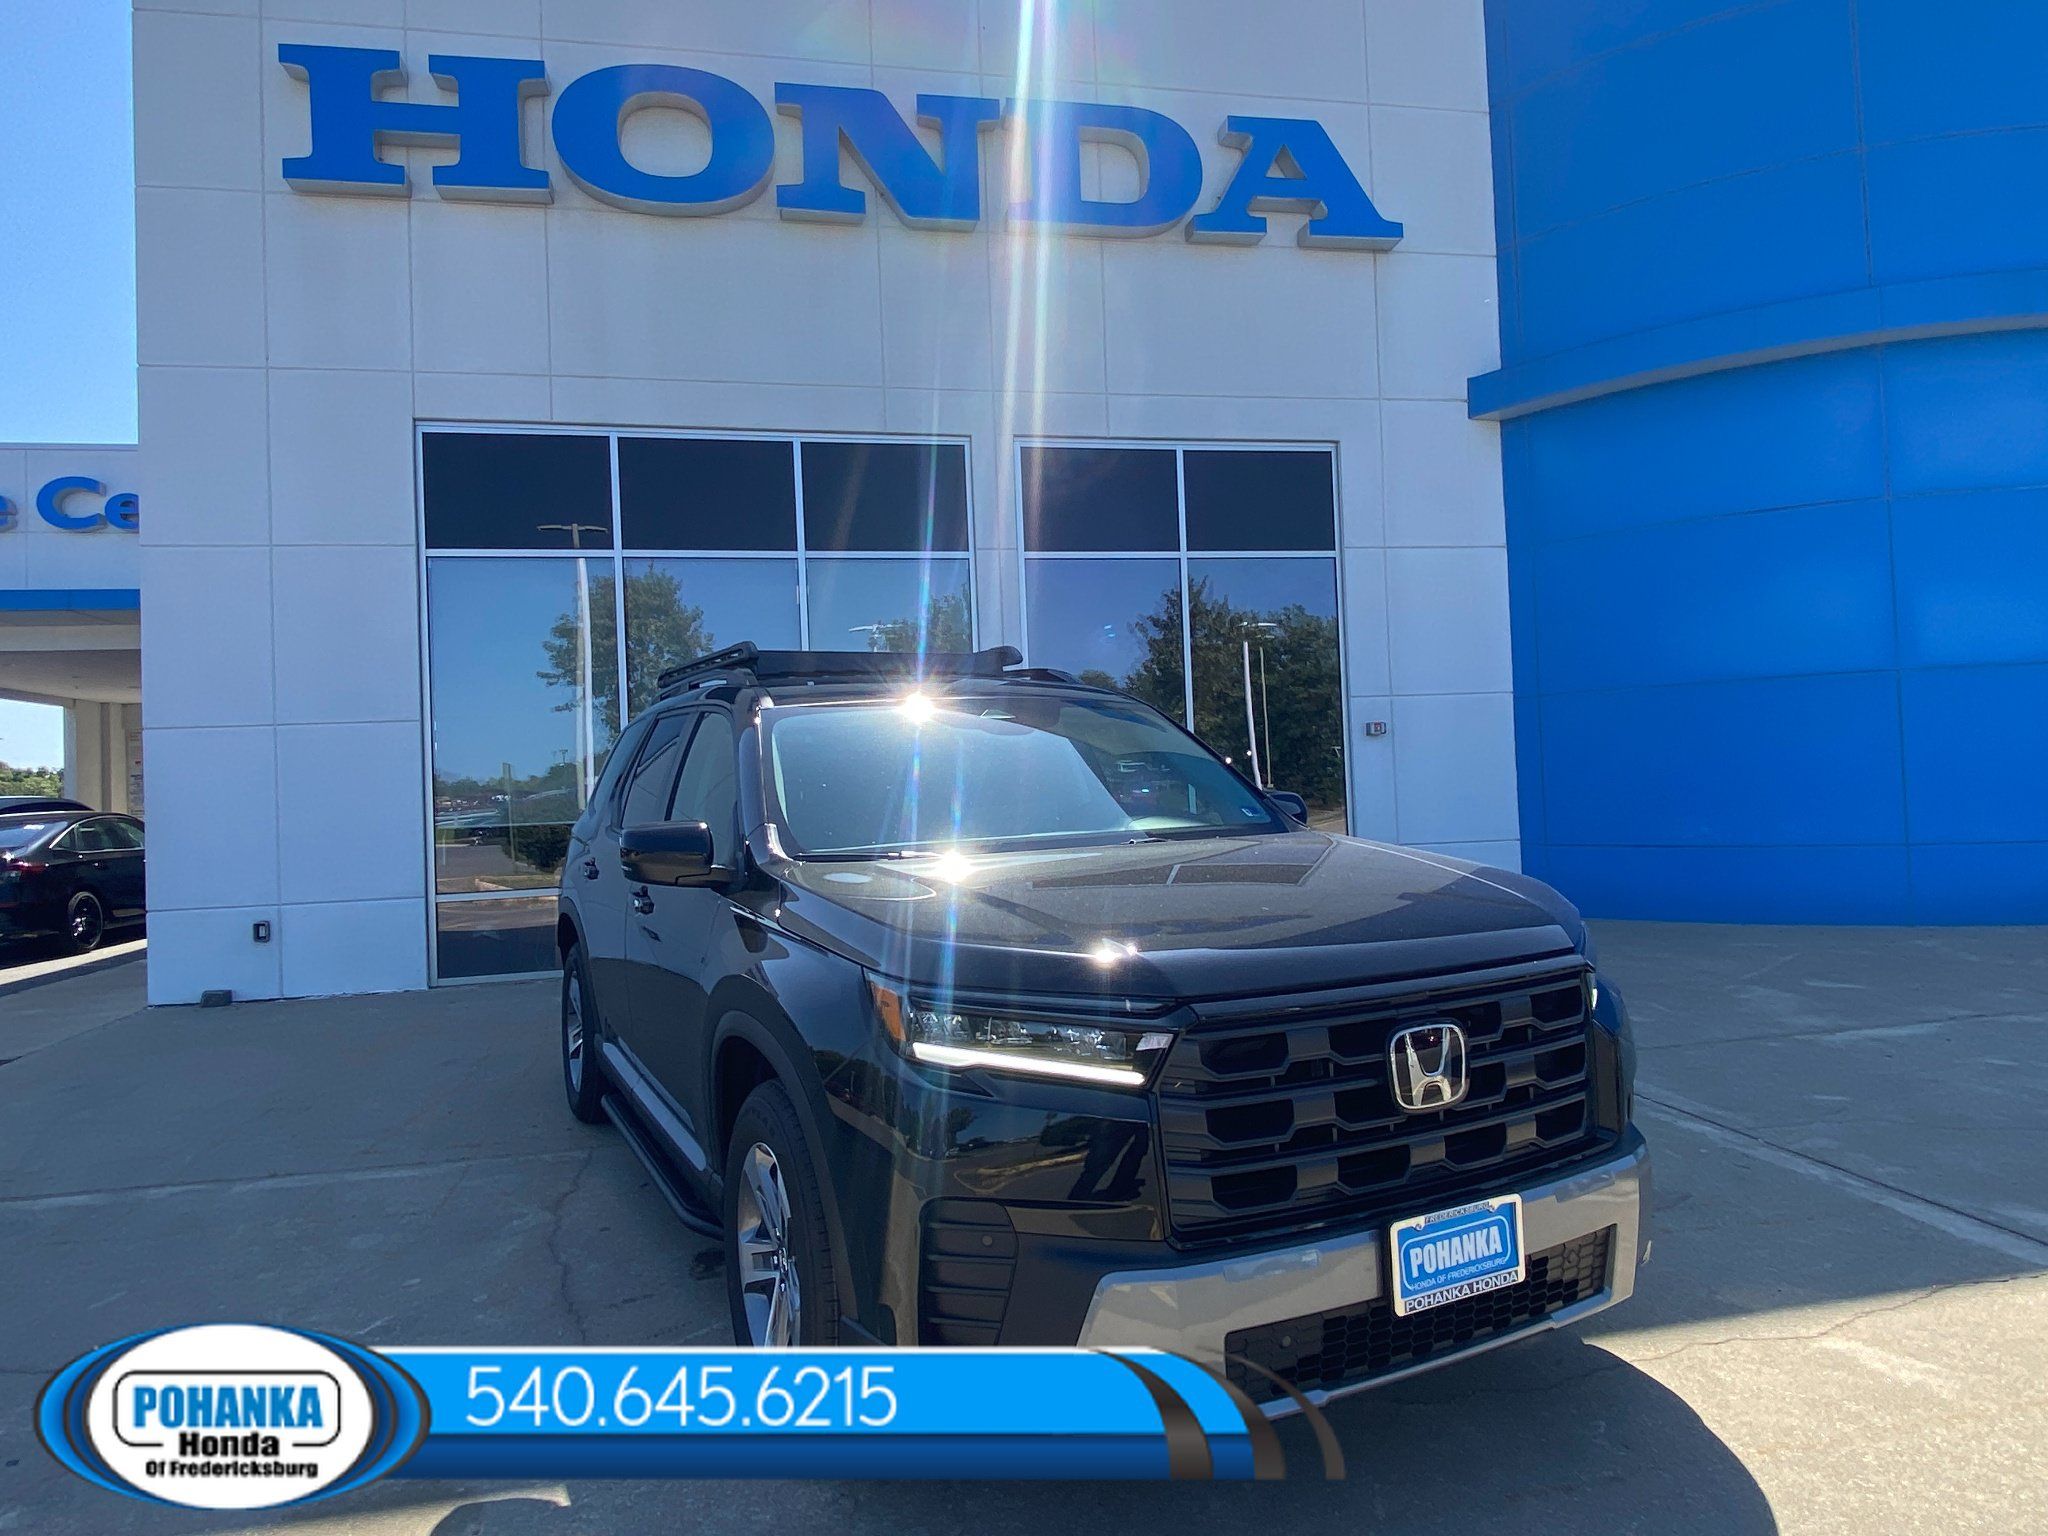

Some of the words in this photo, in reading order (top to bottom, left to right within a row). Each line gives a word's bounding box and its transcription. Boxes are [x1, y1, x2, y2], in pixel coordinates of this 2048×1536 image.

[278, 43, 1403, 249] HONDA
[1409, 1225, 1503, 1279] POHANKA
[1411, 1277, 1437, 1291] HONDA
[1436, 1274, 1447, 1284] OF
[1447, 1257, 1506, 1281] FREDERICKSBURG
[1406, 1284, 1471, 1312] POHANKA
[1473, 1271, 1519, 1292] HONDA
